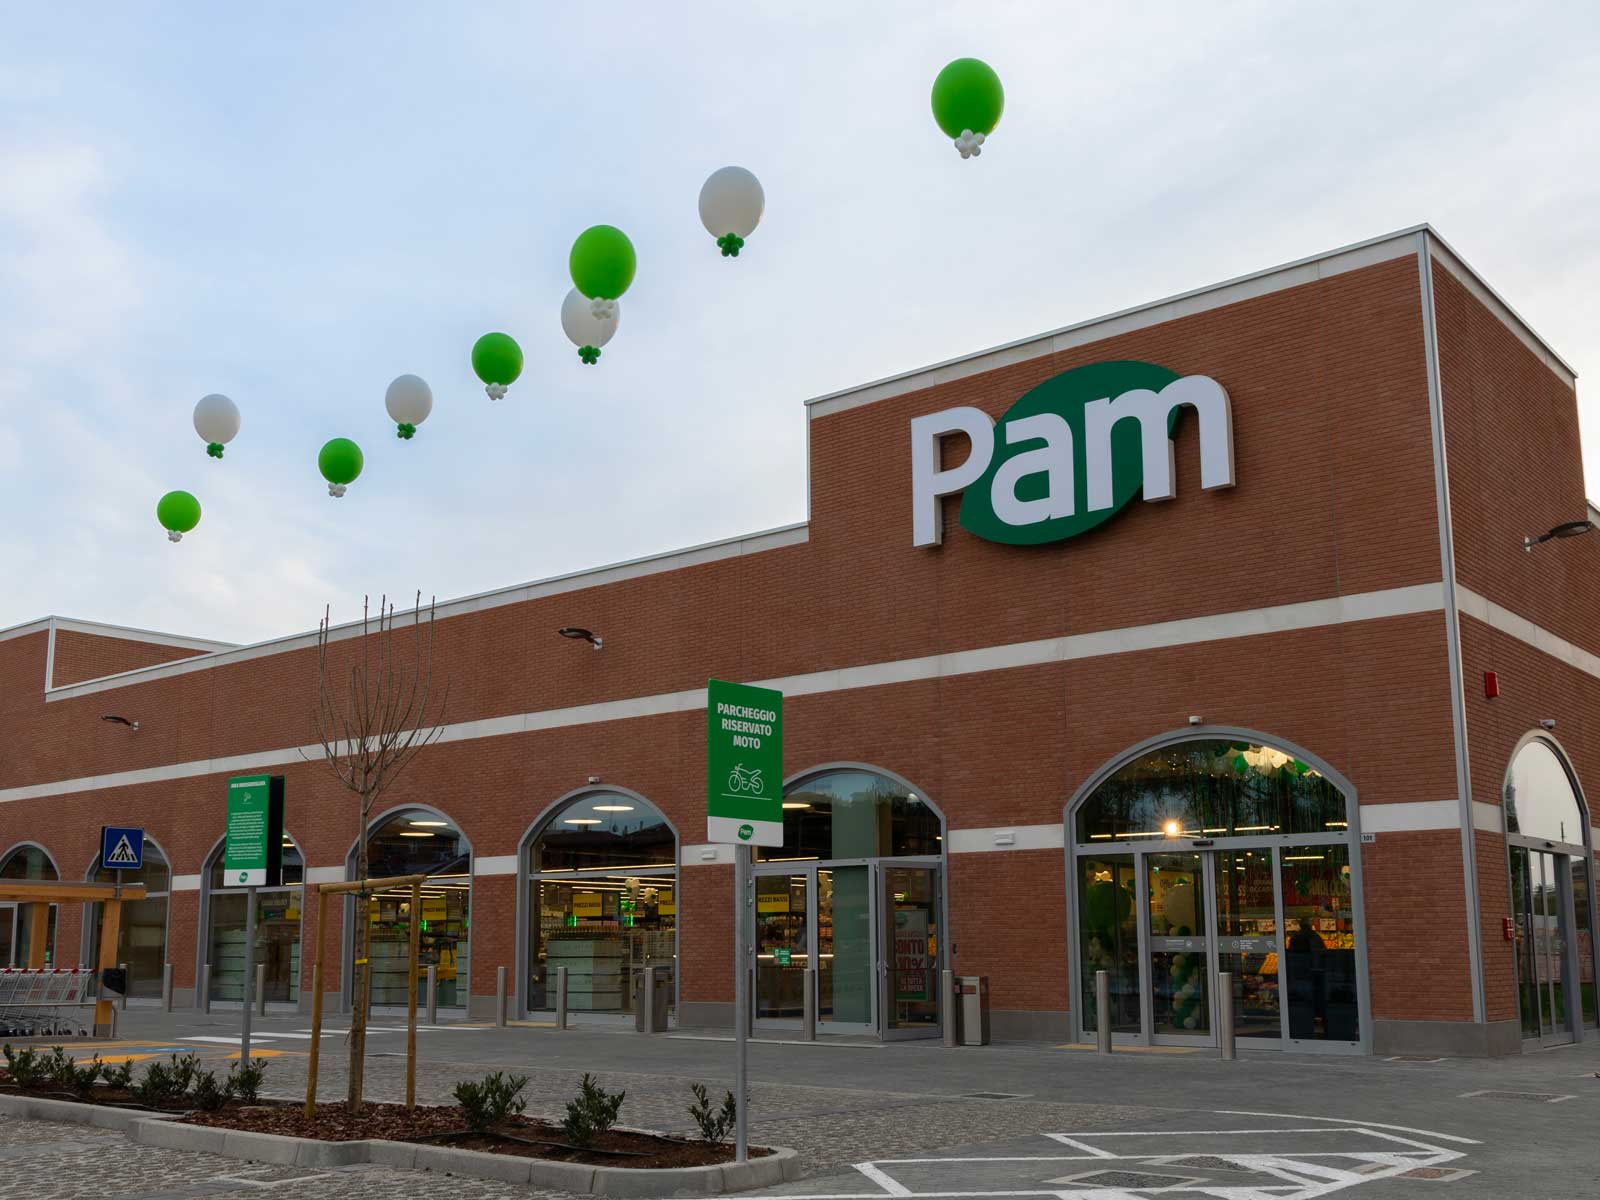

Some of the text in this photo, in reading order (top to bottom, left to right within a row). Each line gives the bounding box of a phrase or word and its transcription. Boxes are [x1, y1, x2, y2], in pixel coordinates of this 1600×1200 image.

[911, 374, 1236, 548] Pam
[717, 702, 776, 722] PARCHEGGIO
[722, 718, 772, 736] RISERVATO
[733, 735, 761, 749] MOTO
